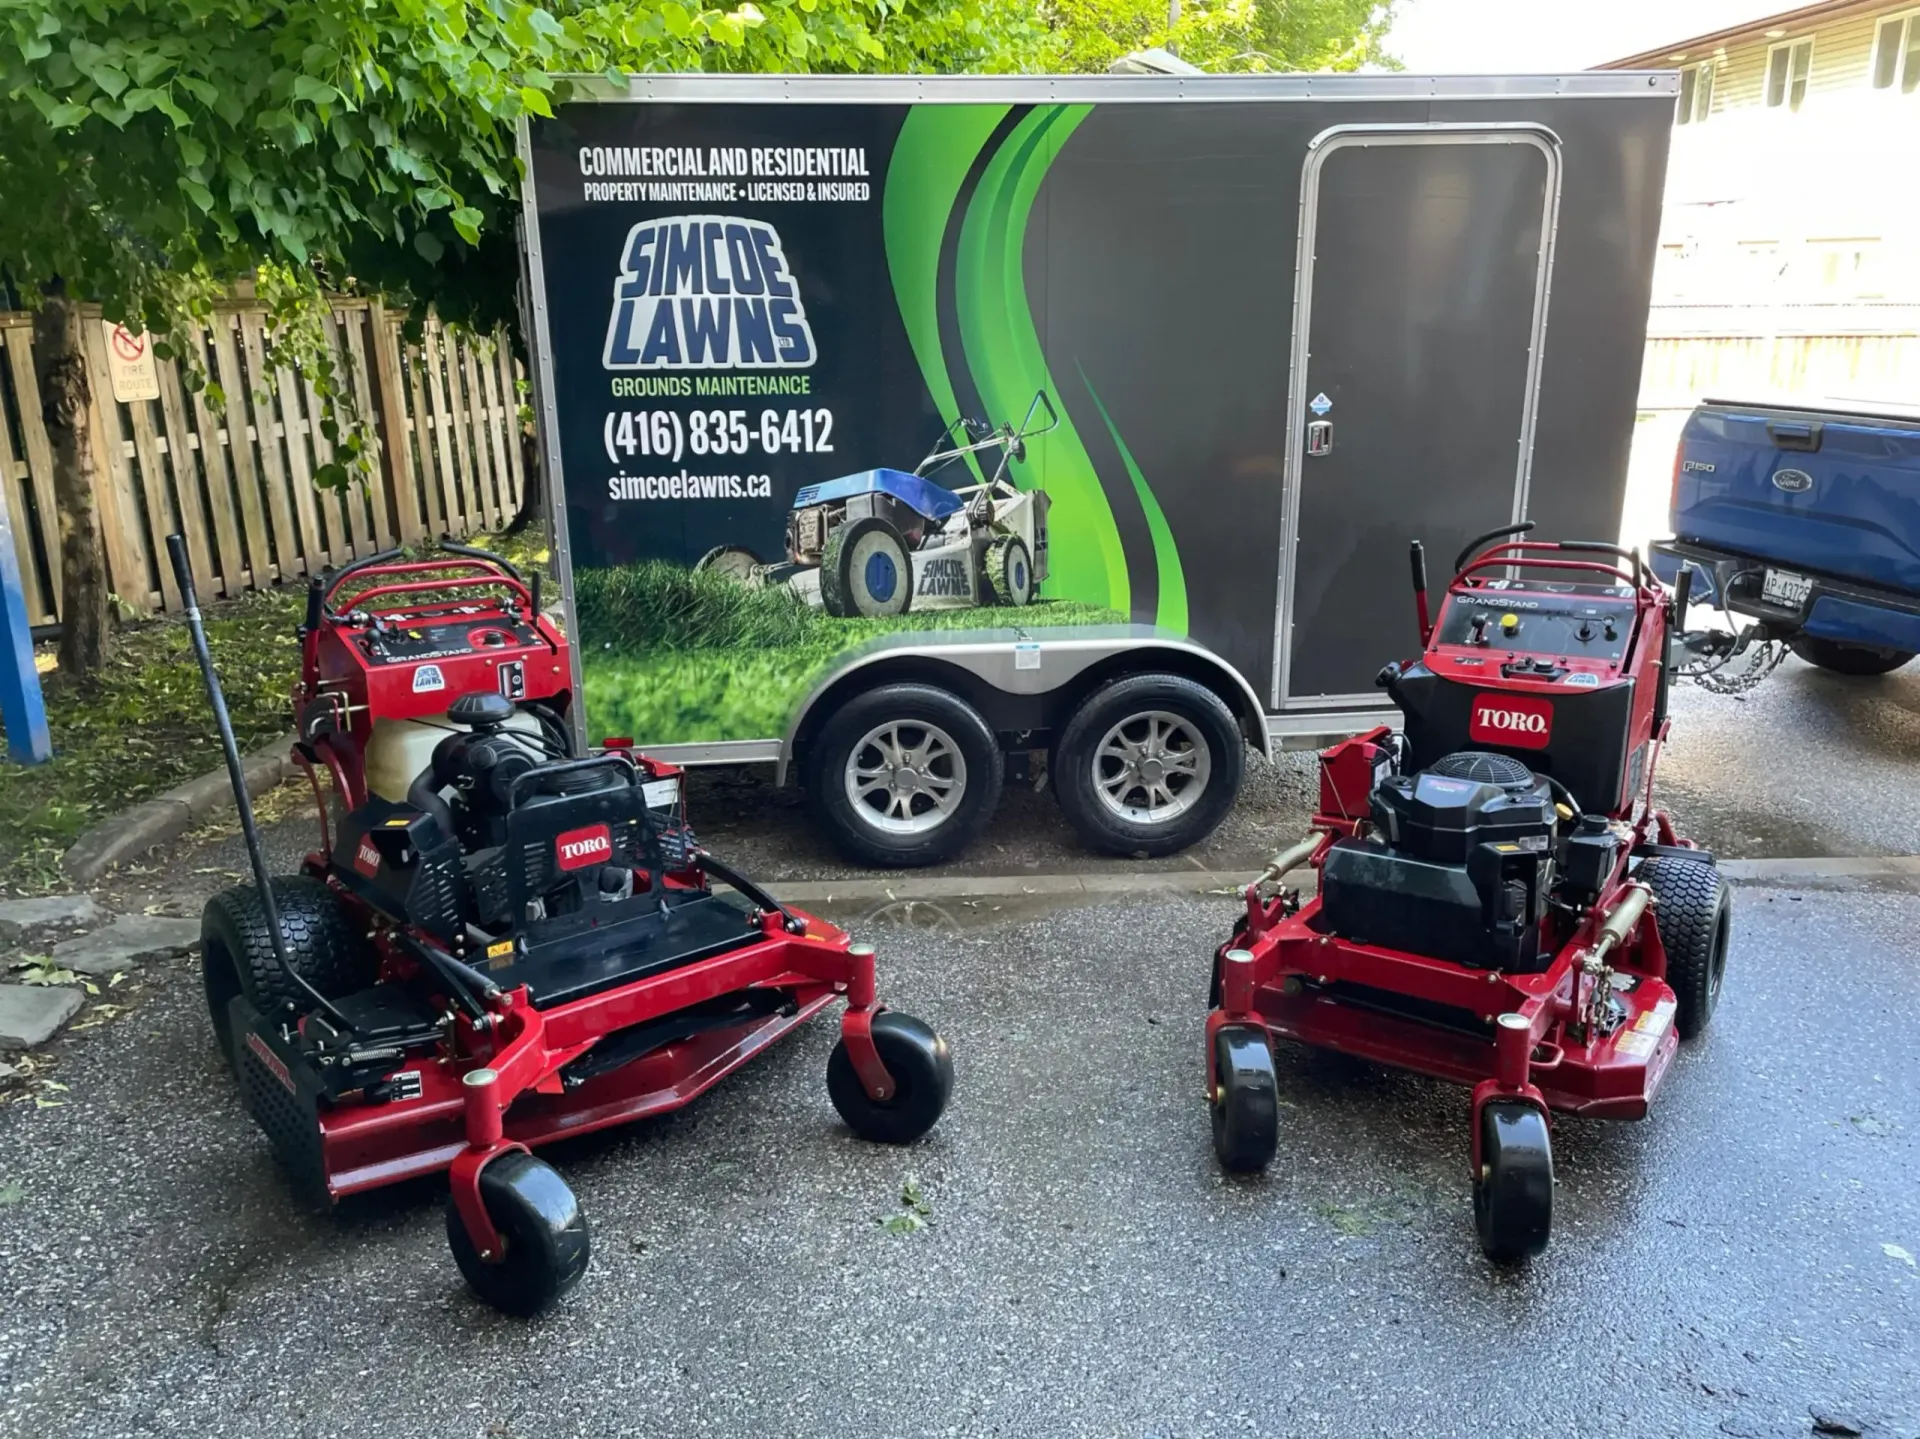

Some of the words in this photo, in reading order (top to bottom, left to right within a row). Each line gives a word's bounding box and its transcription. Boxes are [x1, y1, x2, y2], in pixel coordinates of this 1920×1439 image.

[579, 147, 707, 176] COMMERCIAL
[709, 147, 748, 176] AND
[752, 147, 870, 176] RESIDENTIAL
[584, 182, 647, 201] PROPERTY
[650, 182, 737, 201] MAINTENANCE
[748, 182, 804, 201] LICENSED
[807, 183, 817, 201] &
[818, 182, 870, 201] INSURED
[620, 221, 794, 298] SIMCOE
[608, 297, 811, 365] LAWNS
[778, 337, 791, 348] LTD
[611, 377, 692, 397] GROUNDS
[695, 375, 811, 395] MAINTENANCE
[603, 410, 684, 463] (416)
[689, 408, 834, 454] 835-6412
[608, 469, 772, 500] simcoelawns.ca
[1779, 473, 1801, 488] Ford
[921, 559, 967, 578] SIMCOE
[917, 577, 971, 596] LAWNS
[1477, 708, 1546, 733] TORO
[358, 845, 381, 867] TORO
[561, 836, 609, 860] TORO
